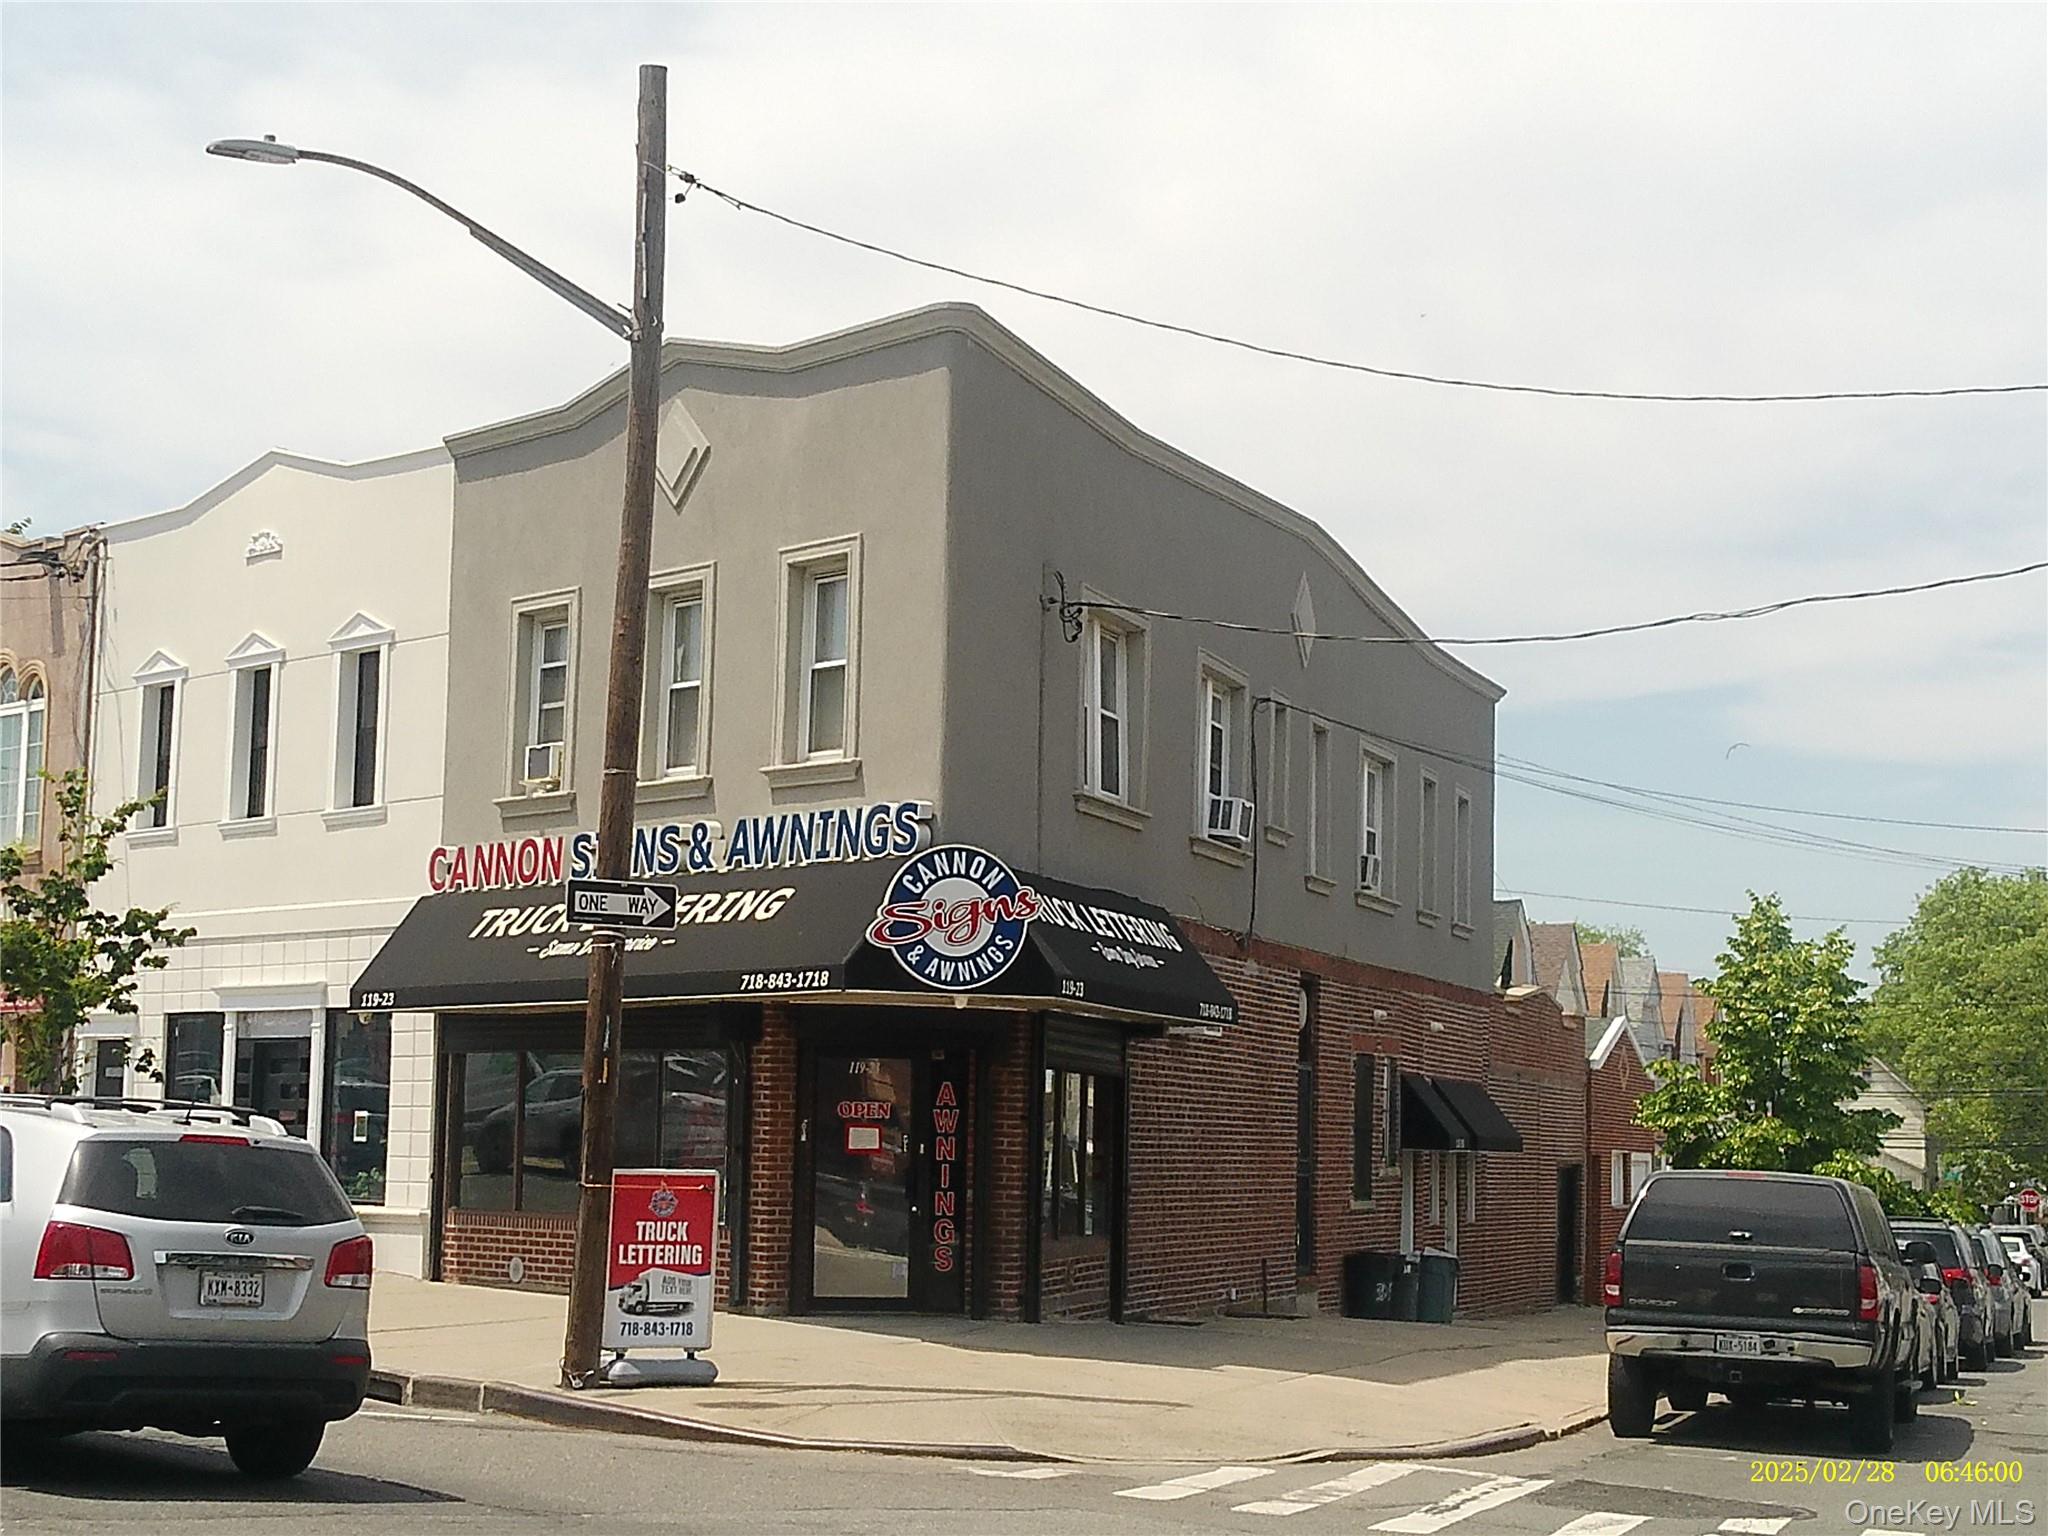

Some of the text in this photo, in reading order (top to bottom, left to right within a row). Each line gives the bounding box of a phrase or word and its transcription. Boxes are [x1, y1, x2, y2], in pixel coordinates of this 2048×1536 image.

[428, 802, 921, 892] CANNON SNS & AWNINGS
[902, 850, 1006, 894] CANNON
[578, 893, 658, 915] ONE WAY
[871, 889, 1039, 946] Signs
[1079, 903, 1184, 953] LETTERING
[906, 934, 1015, 982] & AWNINGS
[740, 970, 830, 991] 718-843-1718
[1061, 978, 1085, 998] 119-23
[360, 992, 396, 1009] 119-23
[837, 1101, 892, 1119] OPEN
[932, 1081, 960, 1272] AWNINGS
[229, 1233, 252, 1244] KIA
[635, 1221, 689, 1242] TRUCK
[618, 1243, 703, 1265] LETTERING
[620, 1321, 694, 1337] 718-843-1718
